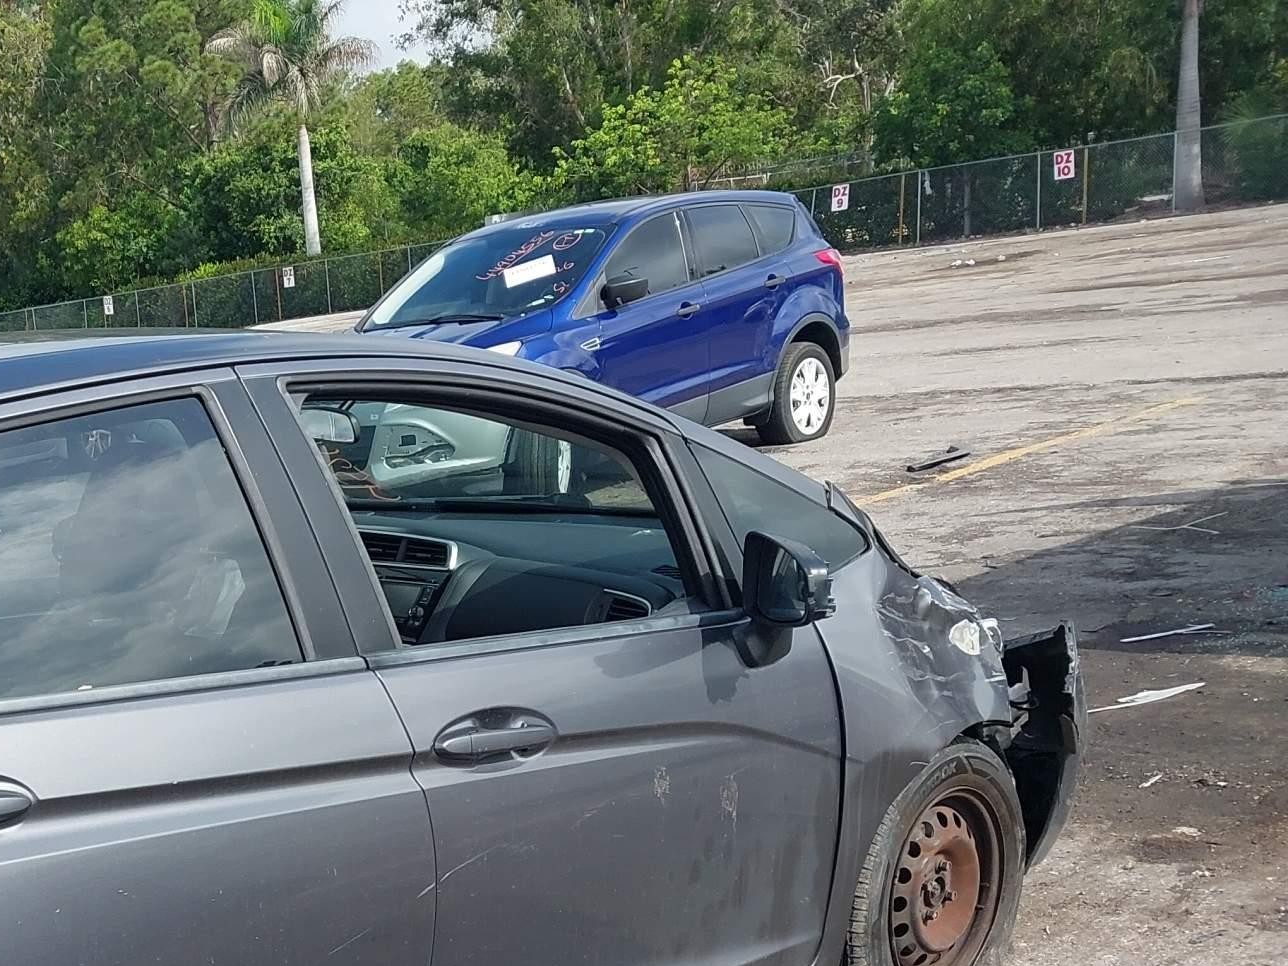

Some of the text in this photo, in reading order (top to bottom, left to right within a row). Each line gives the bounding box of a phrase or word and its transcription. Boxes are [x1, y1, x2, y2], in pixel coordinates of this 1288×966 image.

[1055, 152, 1072, 165] DZ
[1057, 165, 1071, 177] 10
[833, 186, 848, 198] DZ
[837, 198, 843, 208] 9
[284, 269, 293, 277] DZ
